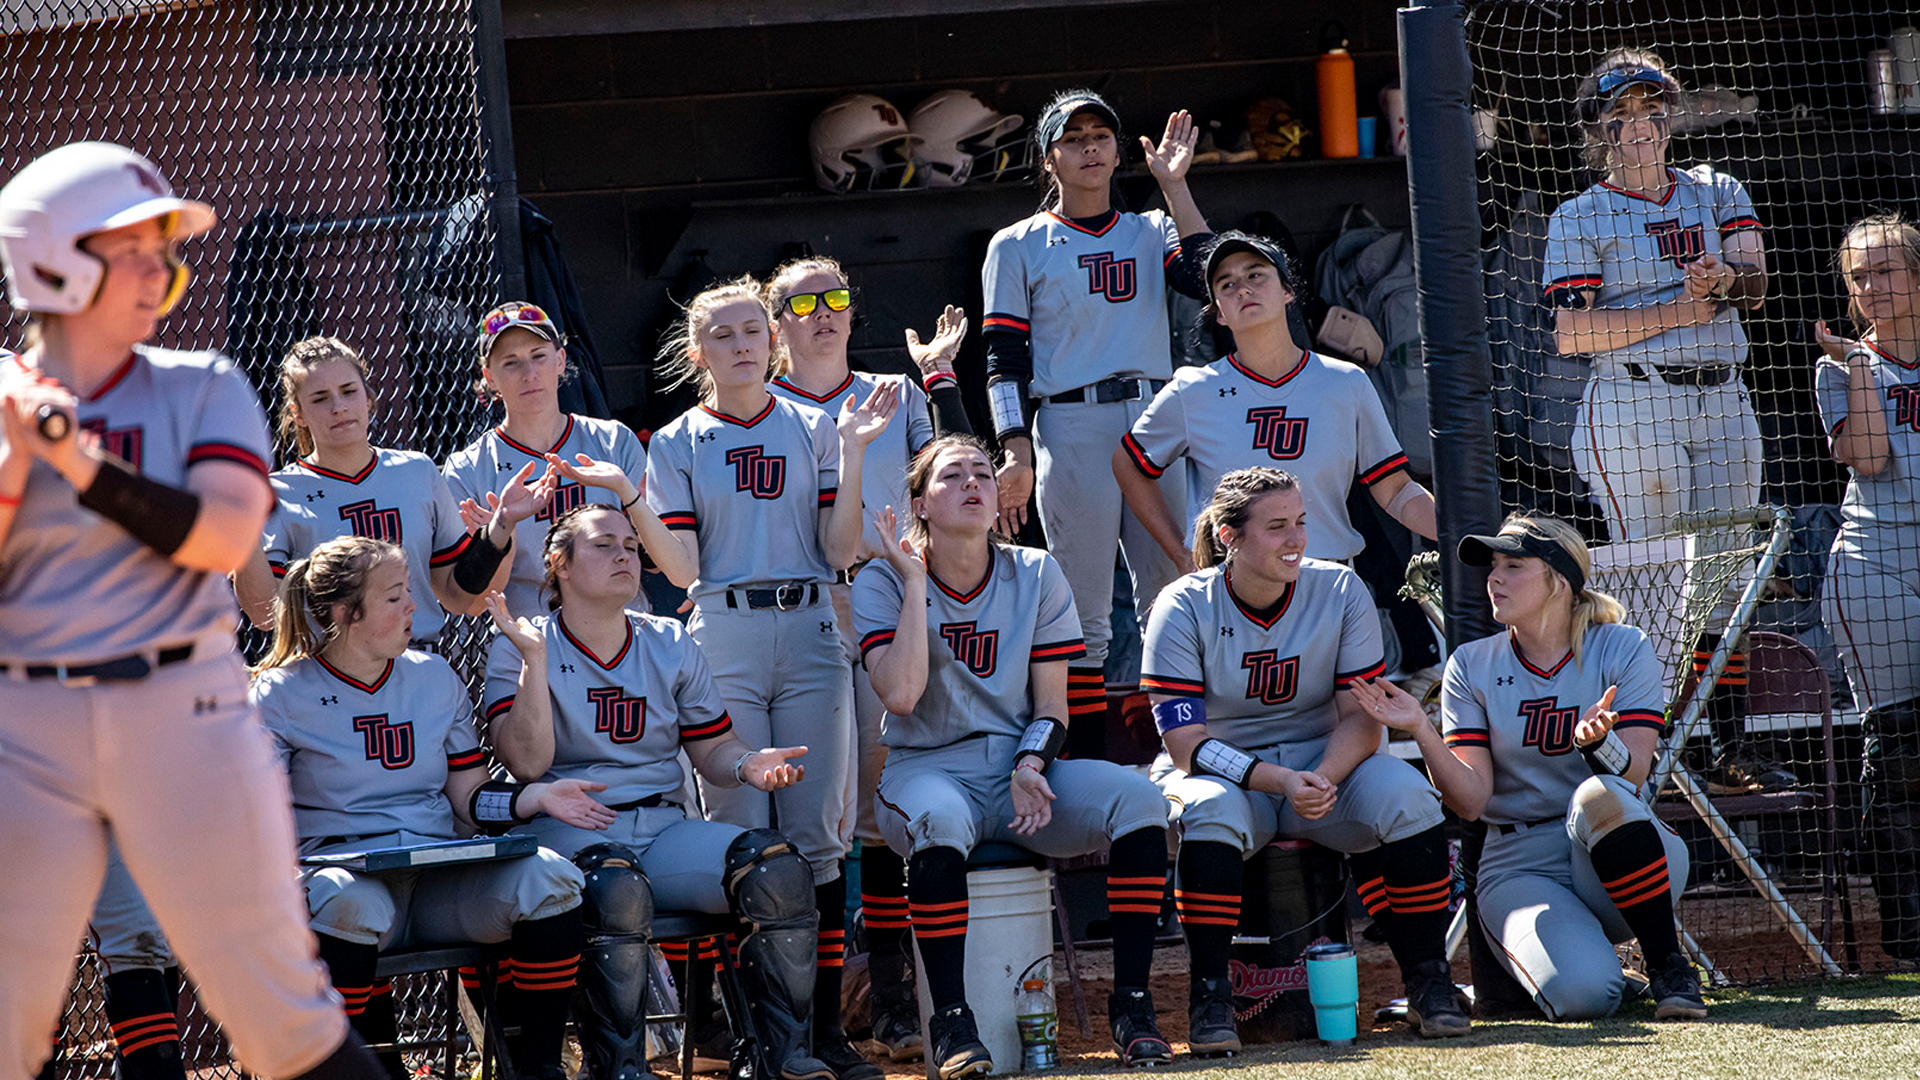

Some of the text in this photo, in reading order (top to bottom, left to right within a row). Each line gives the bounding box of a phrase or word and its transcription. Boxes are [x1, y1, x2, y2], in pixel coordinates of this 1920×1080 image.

[1644, 218, 1706, 269] TU
[1078, 251, 1137, 304] TU
[1246, 405, 1309, 461] TU
[1886, 382, 1920, 433] T
[725, 444, 787, 500] TU
[338, 498, 403, 547] TU
[940, 619, 999, 679] TU
[1241, 648, 1300, 706] TU
[587, 686, 647, 745] TU
[1173, 702, 1193, 723] TS
[1517, 696, 1580, 756] TU
[352, 712, 416, 771] TU
[1227, 959, 1309, 996] Diamo
